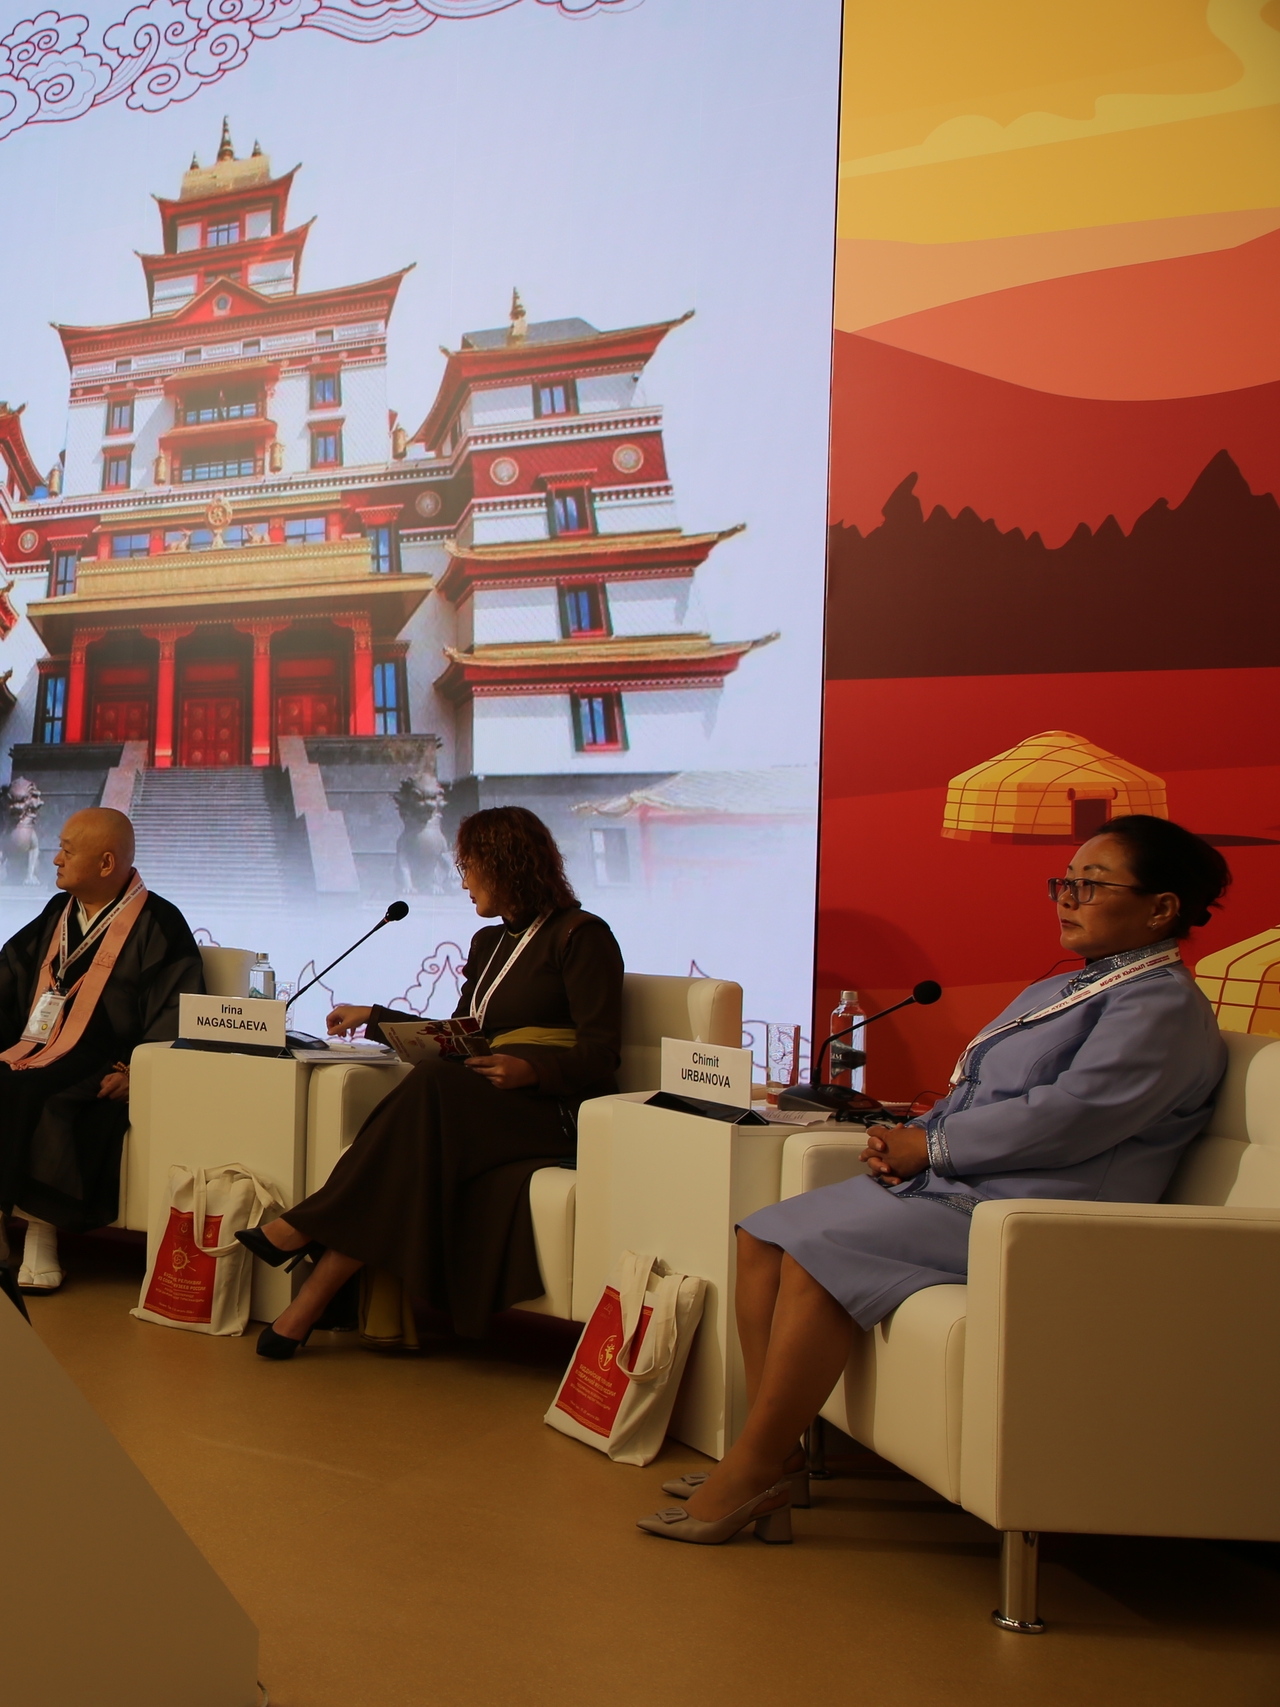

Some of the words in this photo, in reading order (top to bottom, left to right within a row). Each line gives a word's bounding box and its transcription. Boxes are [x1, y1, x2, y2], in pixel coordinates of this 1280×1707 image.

[221, 1004, 243, 1015] Irina
[196, 1016, 268, 1032] NAGASLAEVA
[692, 1052, 719, 1068] Chimit
[681, 1068, 731, 1088] URBANOVA
